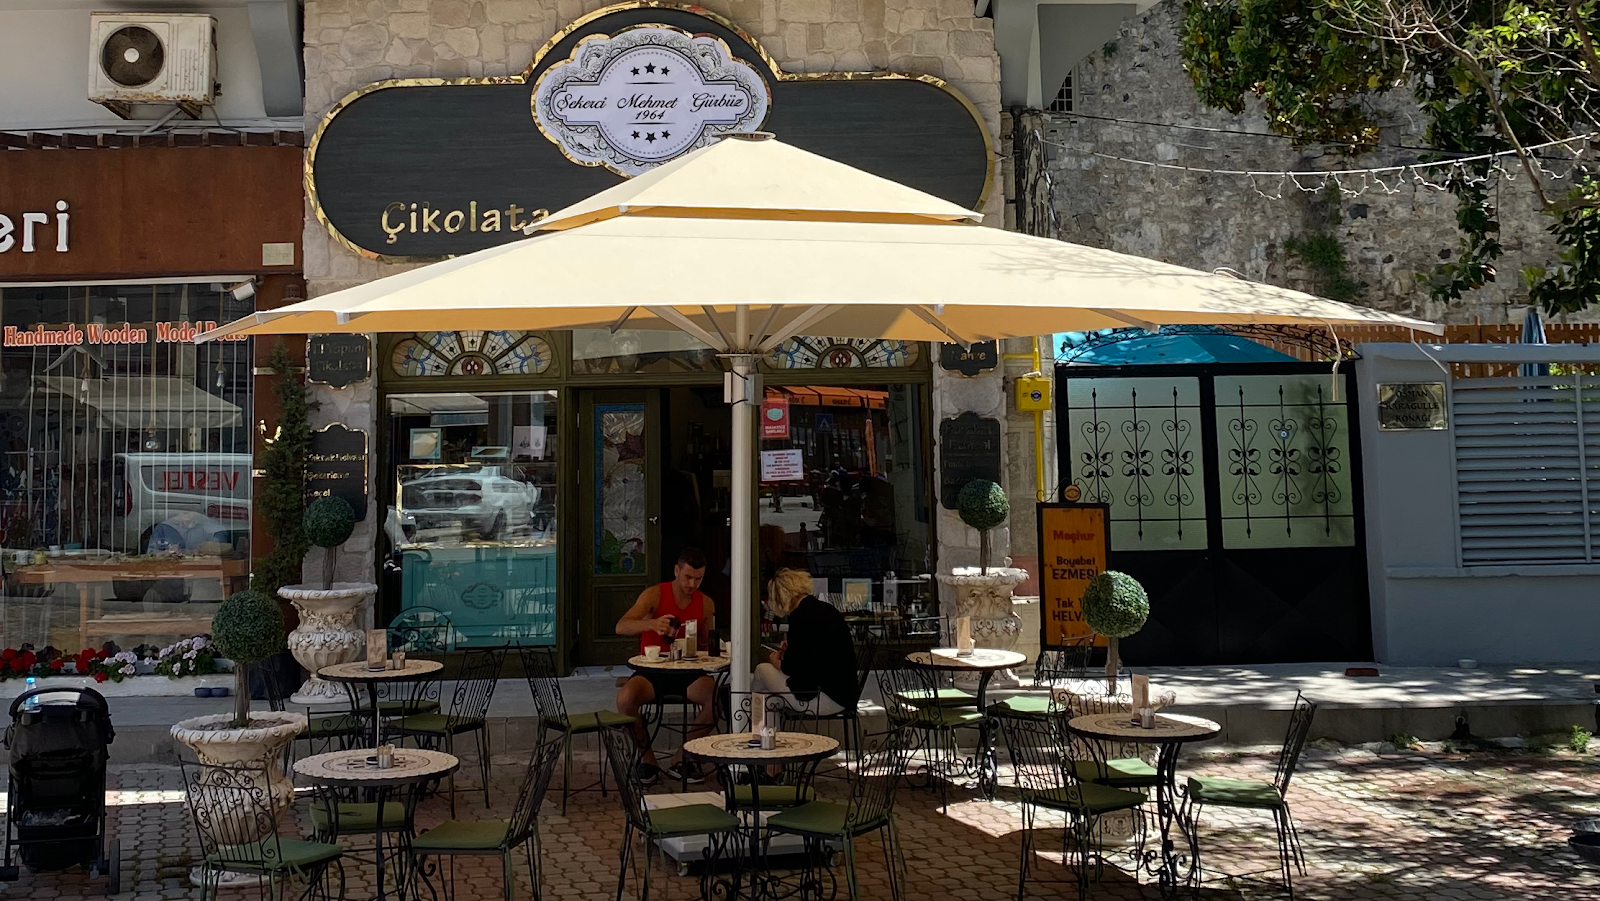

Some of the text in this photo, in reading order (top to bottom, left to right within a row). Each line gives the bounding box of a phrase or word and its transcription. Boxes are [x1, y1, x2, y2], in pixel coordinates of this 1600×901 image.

[557, 93, 744, 112] Şekerci Mehmet Gürbüz
[635, 110, 665, 120] 1964
[4, 324, 83, 346] Handmade
[87, 322, 147, 344] Wooden
[156, 321, 201, 342] Model
[1053, 530, 1095, 543] Meşhur
[1056, 556, 1096, 567] Boyabat
[1055, 597, 1074, 608] Tak
[1052, 611, 1085, 621] HELV
